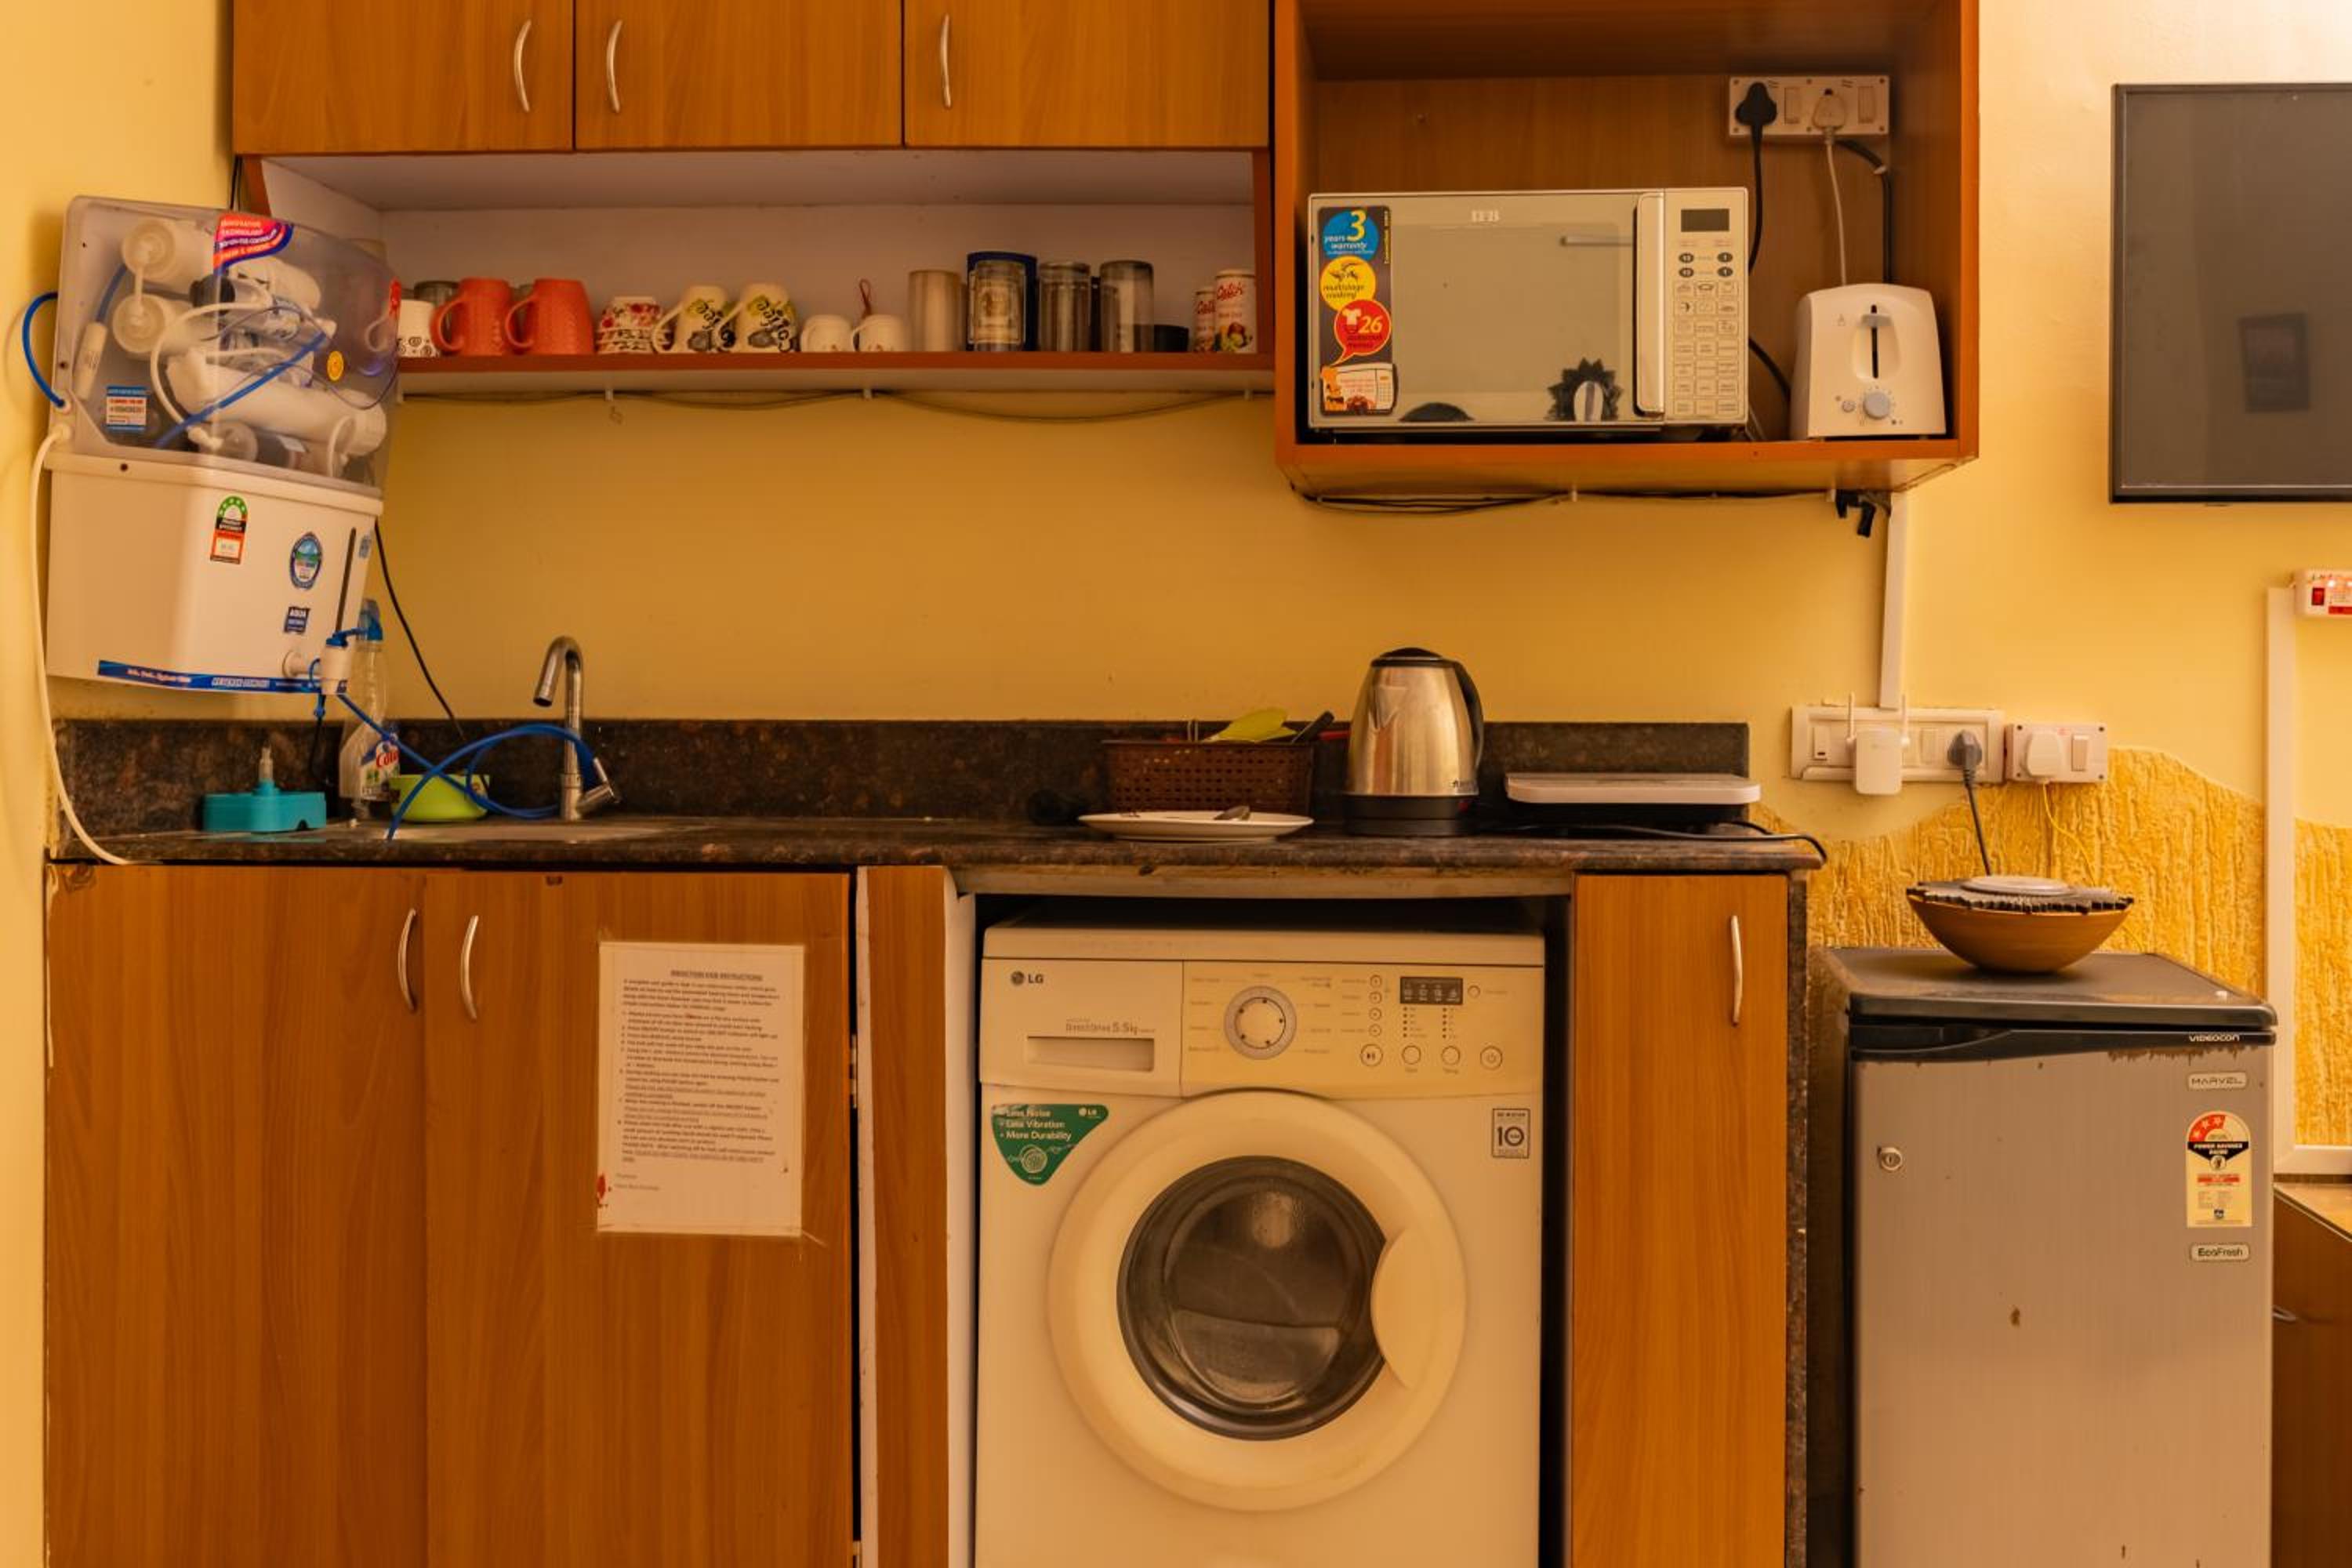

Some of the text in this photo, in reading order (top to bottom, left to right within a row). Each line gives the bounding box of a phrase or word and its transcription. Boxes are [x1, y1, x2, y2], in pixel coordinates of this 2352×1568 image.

[1347, 209, 1367, 241] 3
[1323, 235, 1345, 245] years
[1330, 241, 1368, 251] warranty
[1358, 315, 1383, 333] 26
[1027, 974, 1044, 985] LG
[2188, 1034, 2241, 1043] VIDEOCON
[1027, 1109, 1052, 1117] Noise
[1027, 1120, 1066, 1129] Vibration
[1006, 1131, 1073, 1142] More Durability
[1497, 1126, 1525, 1146] 10
[2198, 1247, 2243, 1257] EcoFresh
